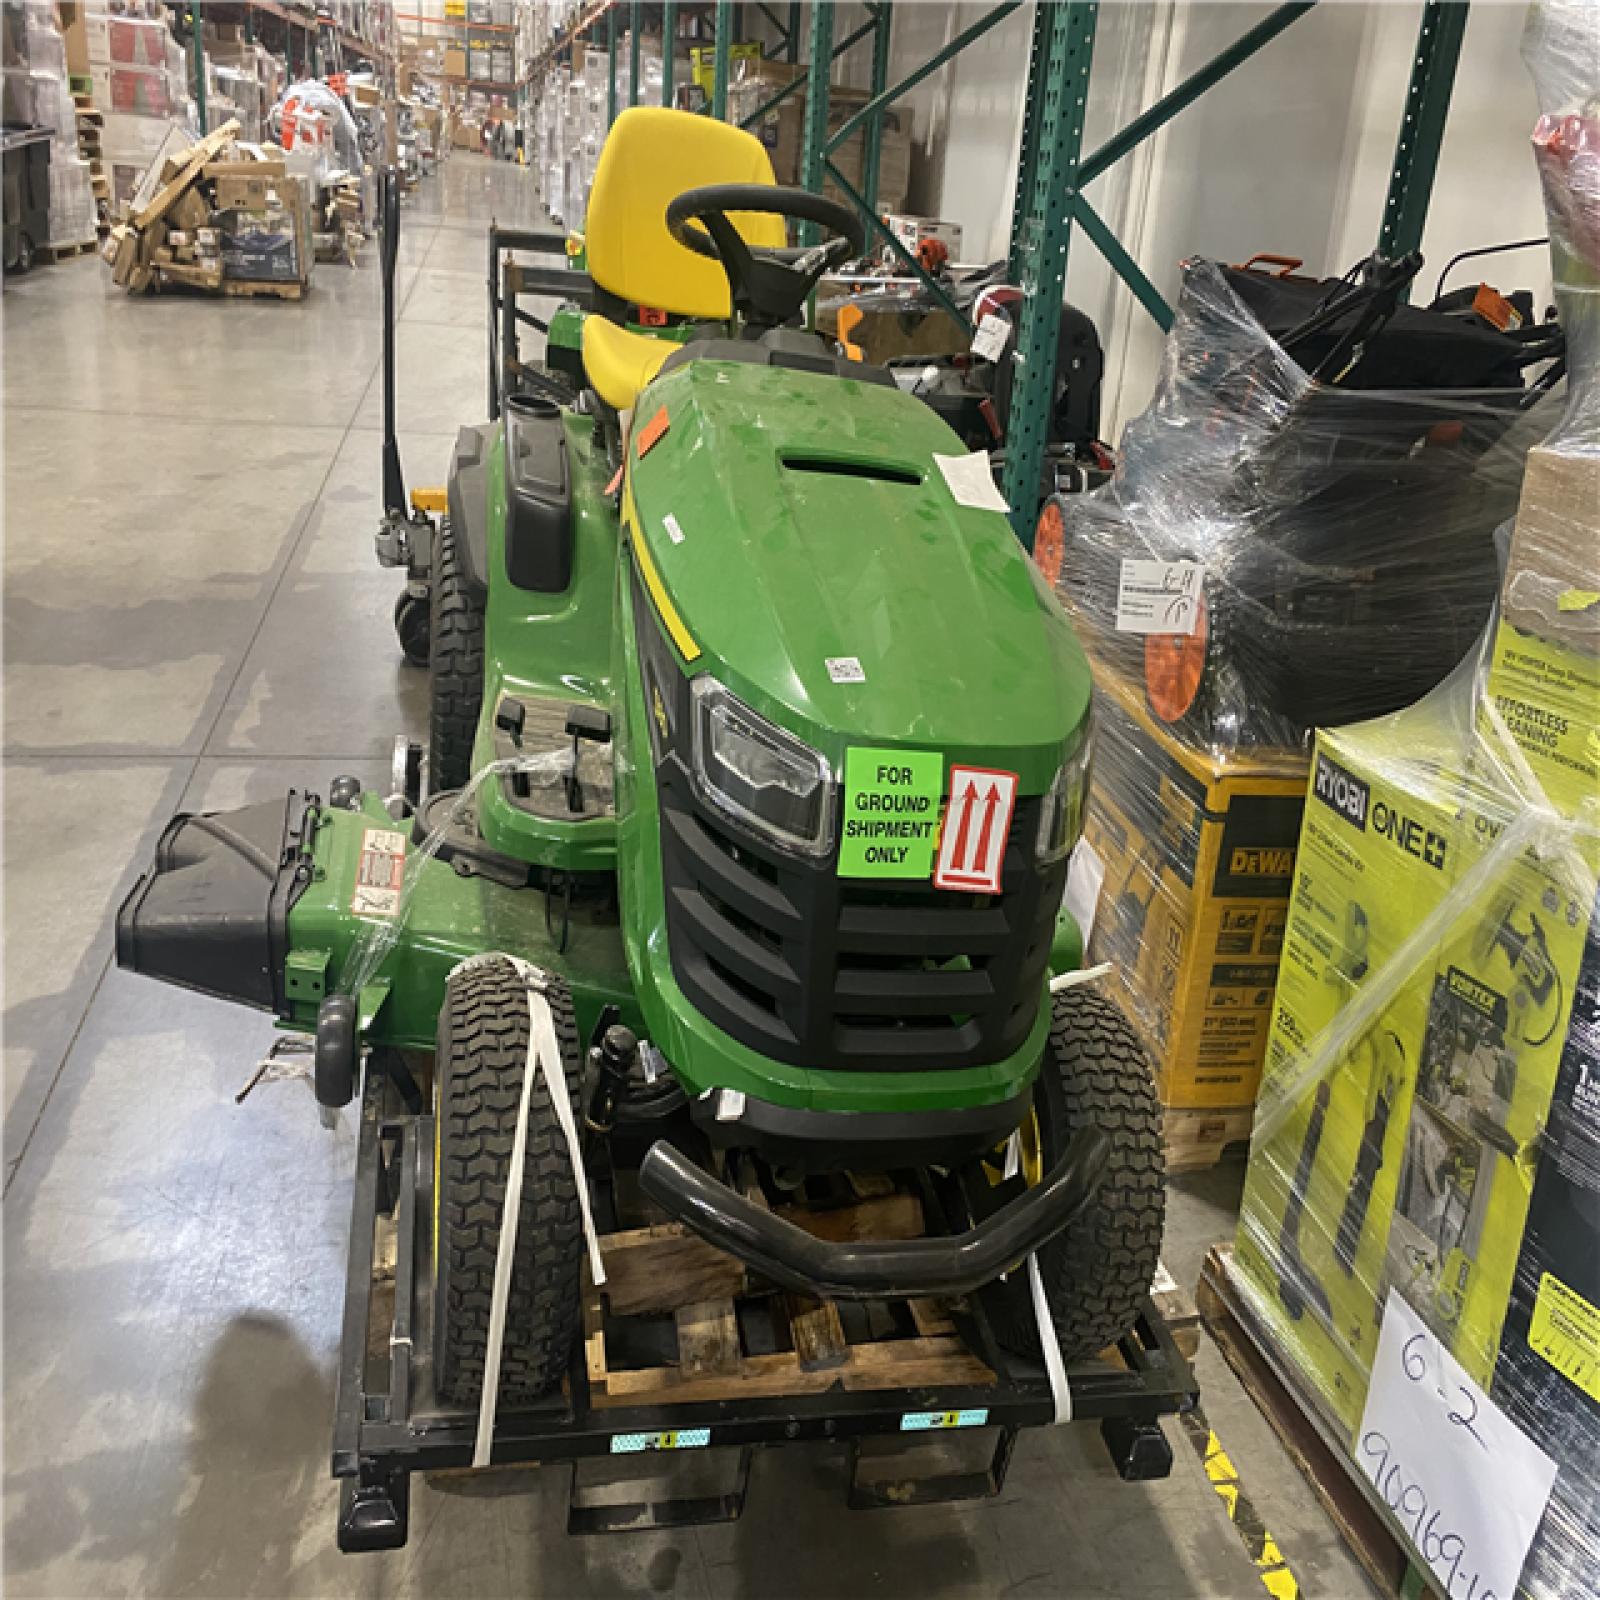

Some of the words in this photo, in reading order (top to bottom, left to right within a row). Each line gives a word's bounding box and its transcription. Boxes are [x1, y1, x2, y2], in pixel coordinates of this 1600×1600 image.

[877, 765, 913, 785] FOR
[1316, 760, 1366, 821] RYOBI
[855, 792, 931, 812] GROUND
[846, 819, 933, 838] SHIPMENT
[864, 846, 908, 863] ONLY
